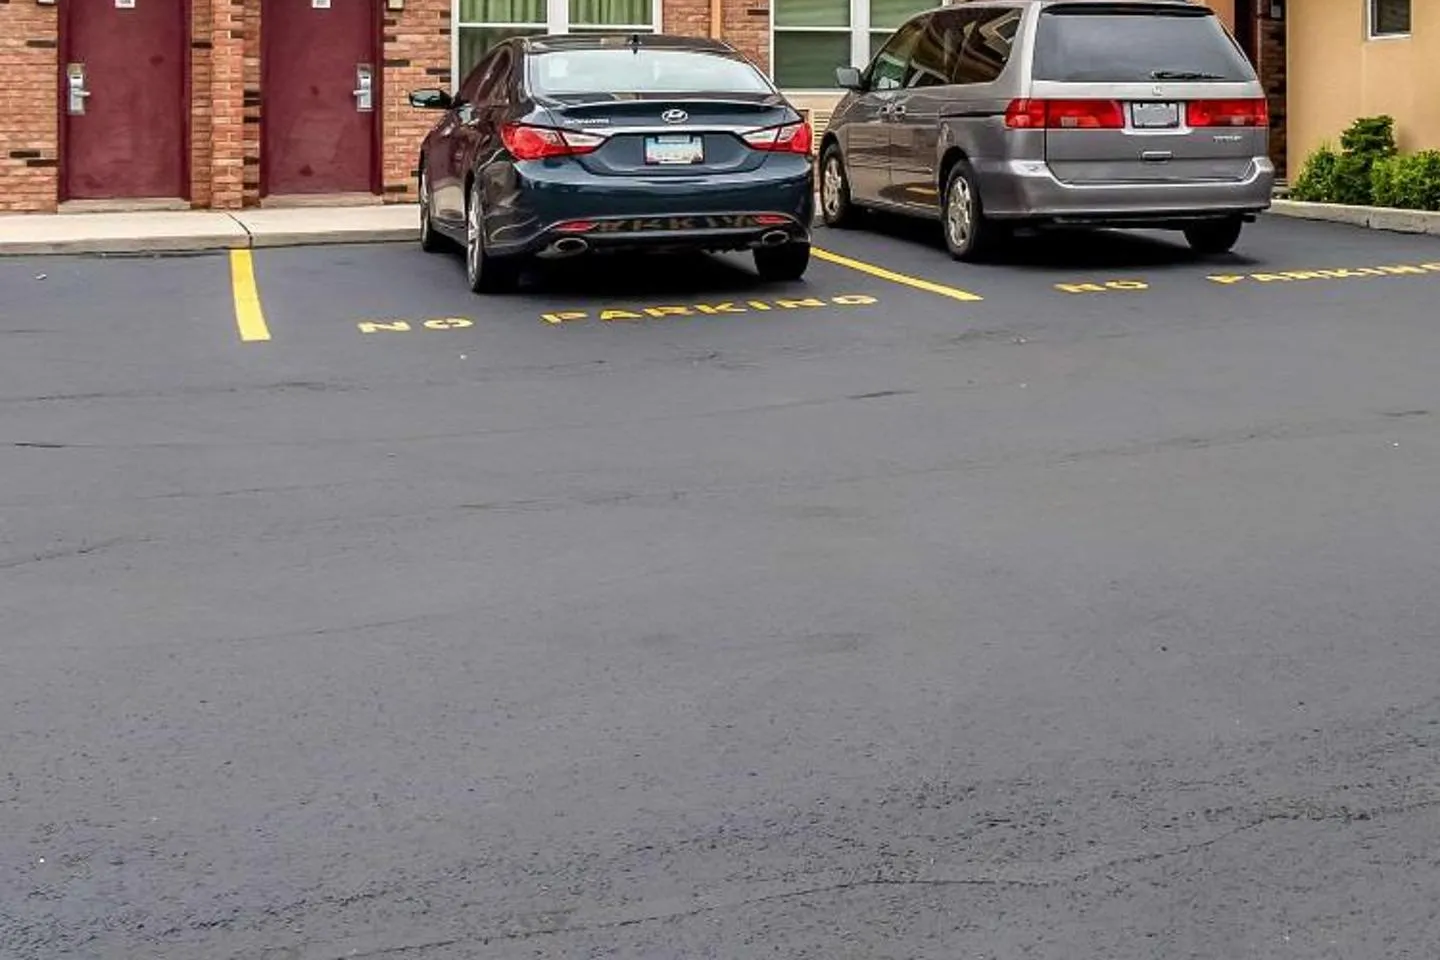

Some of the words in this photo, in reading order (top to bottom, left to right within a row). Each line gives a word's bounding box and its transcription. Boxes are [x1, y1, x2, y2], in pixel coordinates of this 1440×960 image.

[1055, 279, 1149, 293] NO
[357, 317, 474, 333] NO
[540, 295, 878, 323] PARKING
